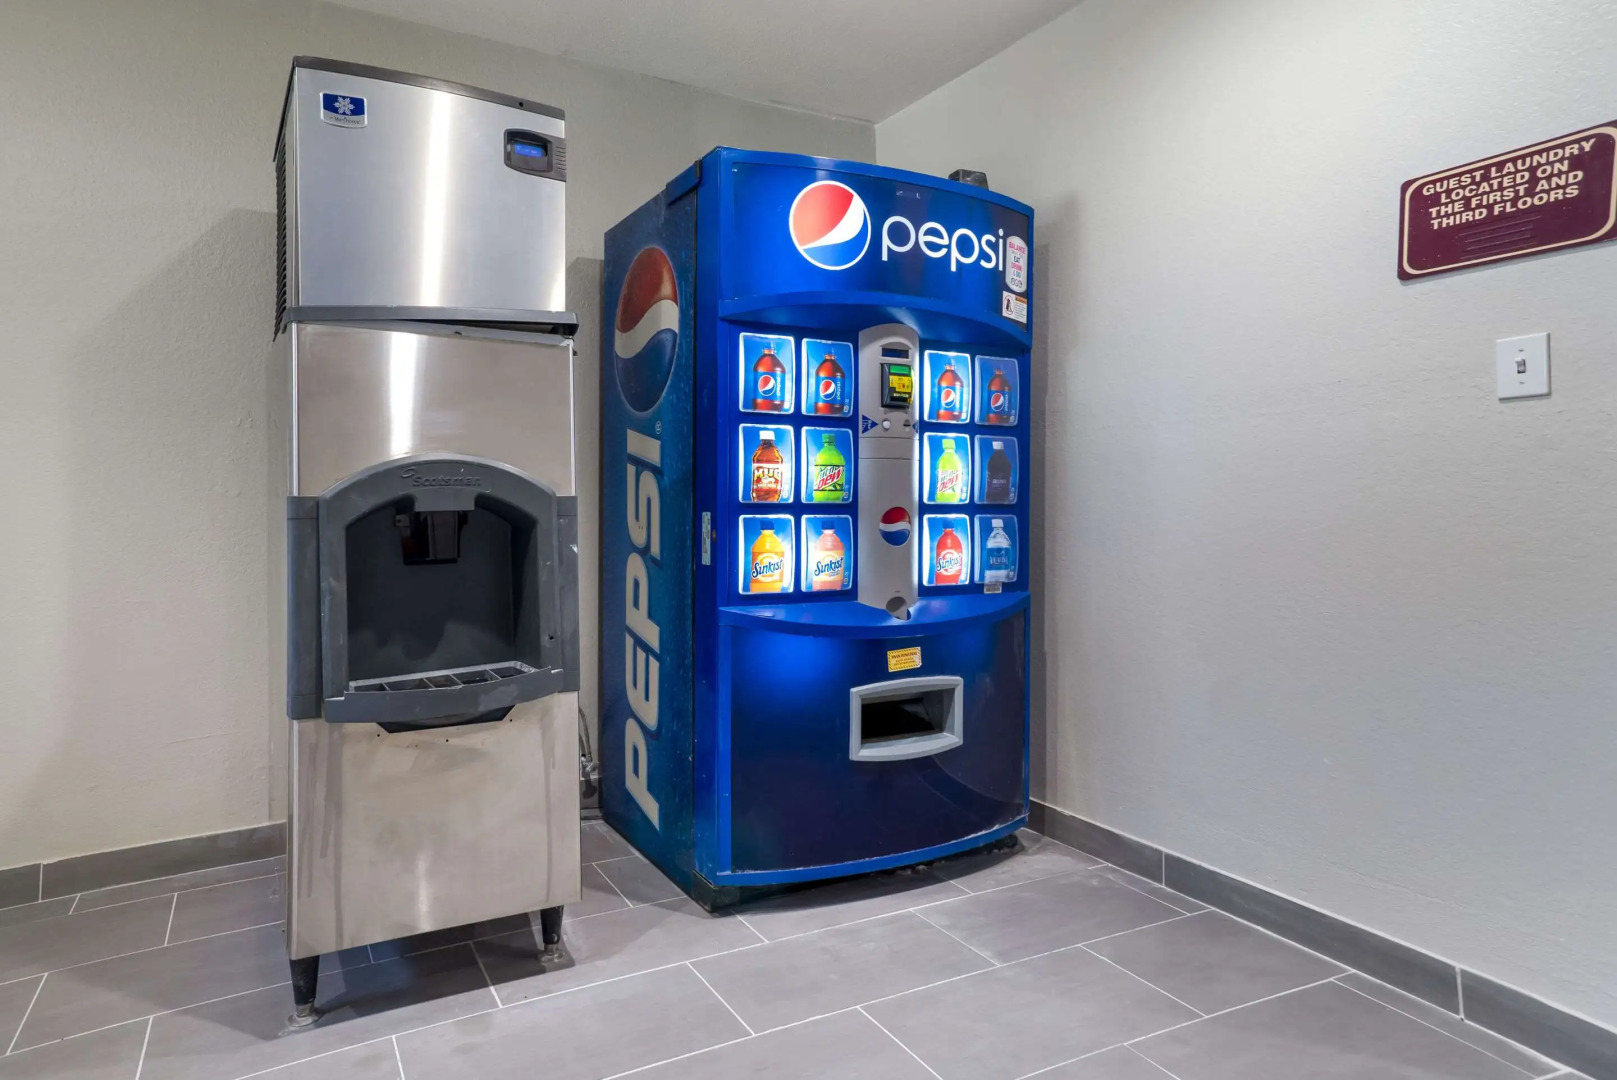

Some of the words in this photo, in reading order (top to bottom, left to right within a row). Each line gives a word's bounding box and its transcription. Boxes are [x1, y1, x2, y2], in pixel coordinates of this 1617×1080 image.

[1422, 170, 1484, 196] GUEST
[1490, 137, 1597, 178] LAUNDRY
[1441, 171, 1530, 204] LOCATED
[1536, 160, 1569, 178] ON
[1429, 201, 1465, 218] THE
[1470, 184, 1529, 209] FIRST
[1535, 170, 1584, 192] AND
[1430, 208, 1488, 230] THIRD
[1493, 185, 1580, 216] FLOORS
[881, 215, 1004, 272] pepsi
[751, 558, 783, 578] Sunkist
[814, 556, 844, 577] Sunkist
[625, 428, 662, 831] PEPSI
